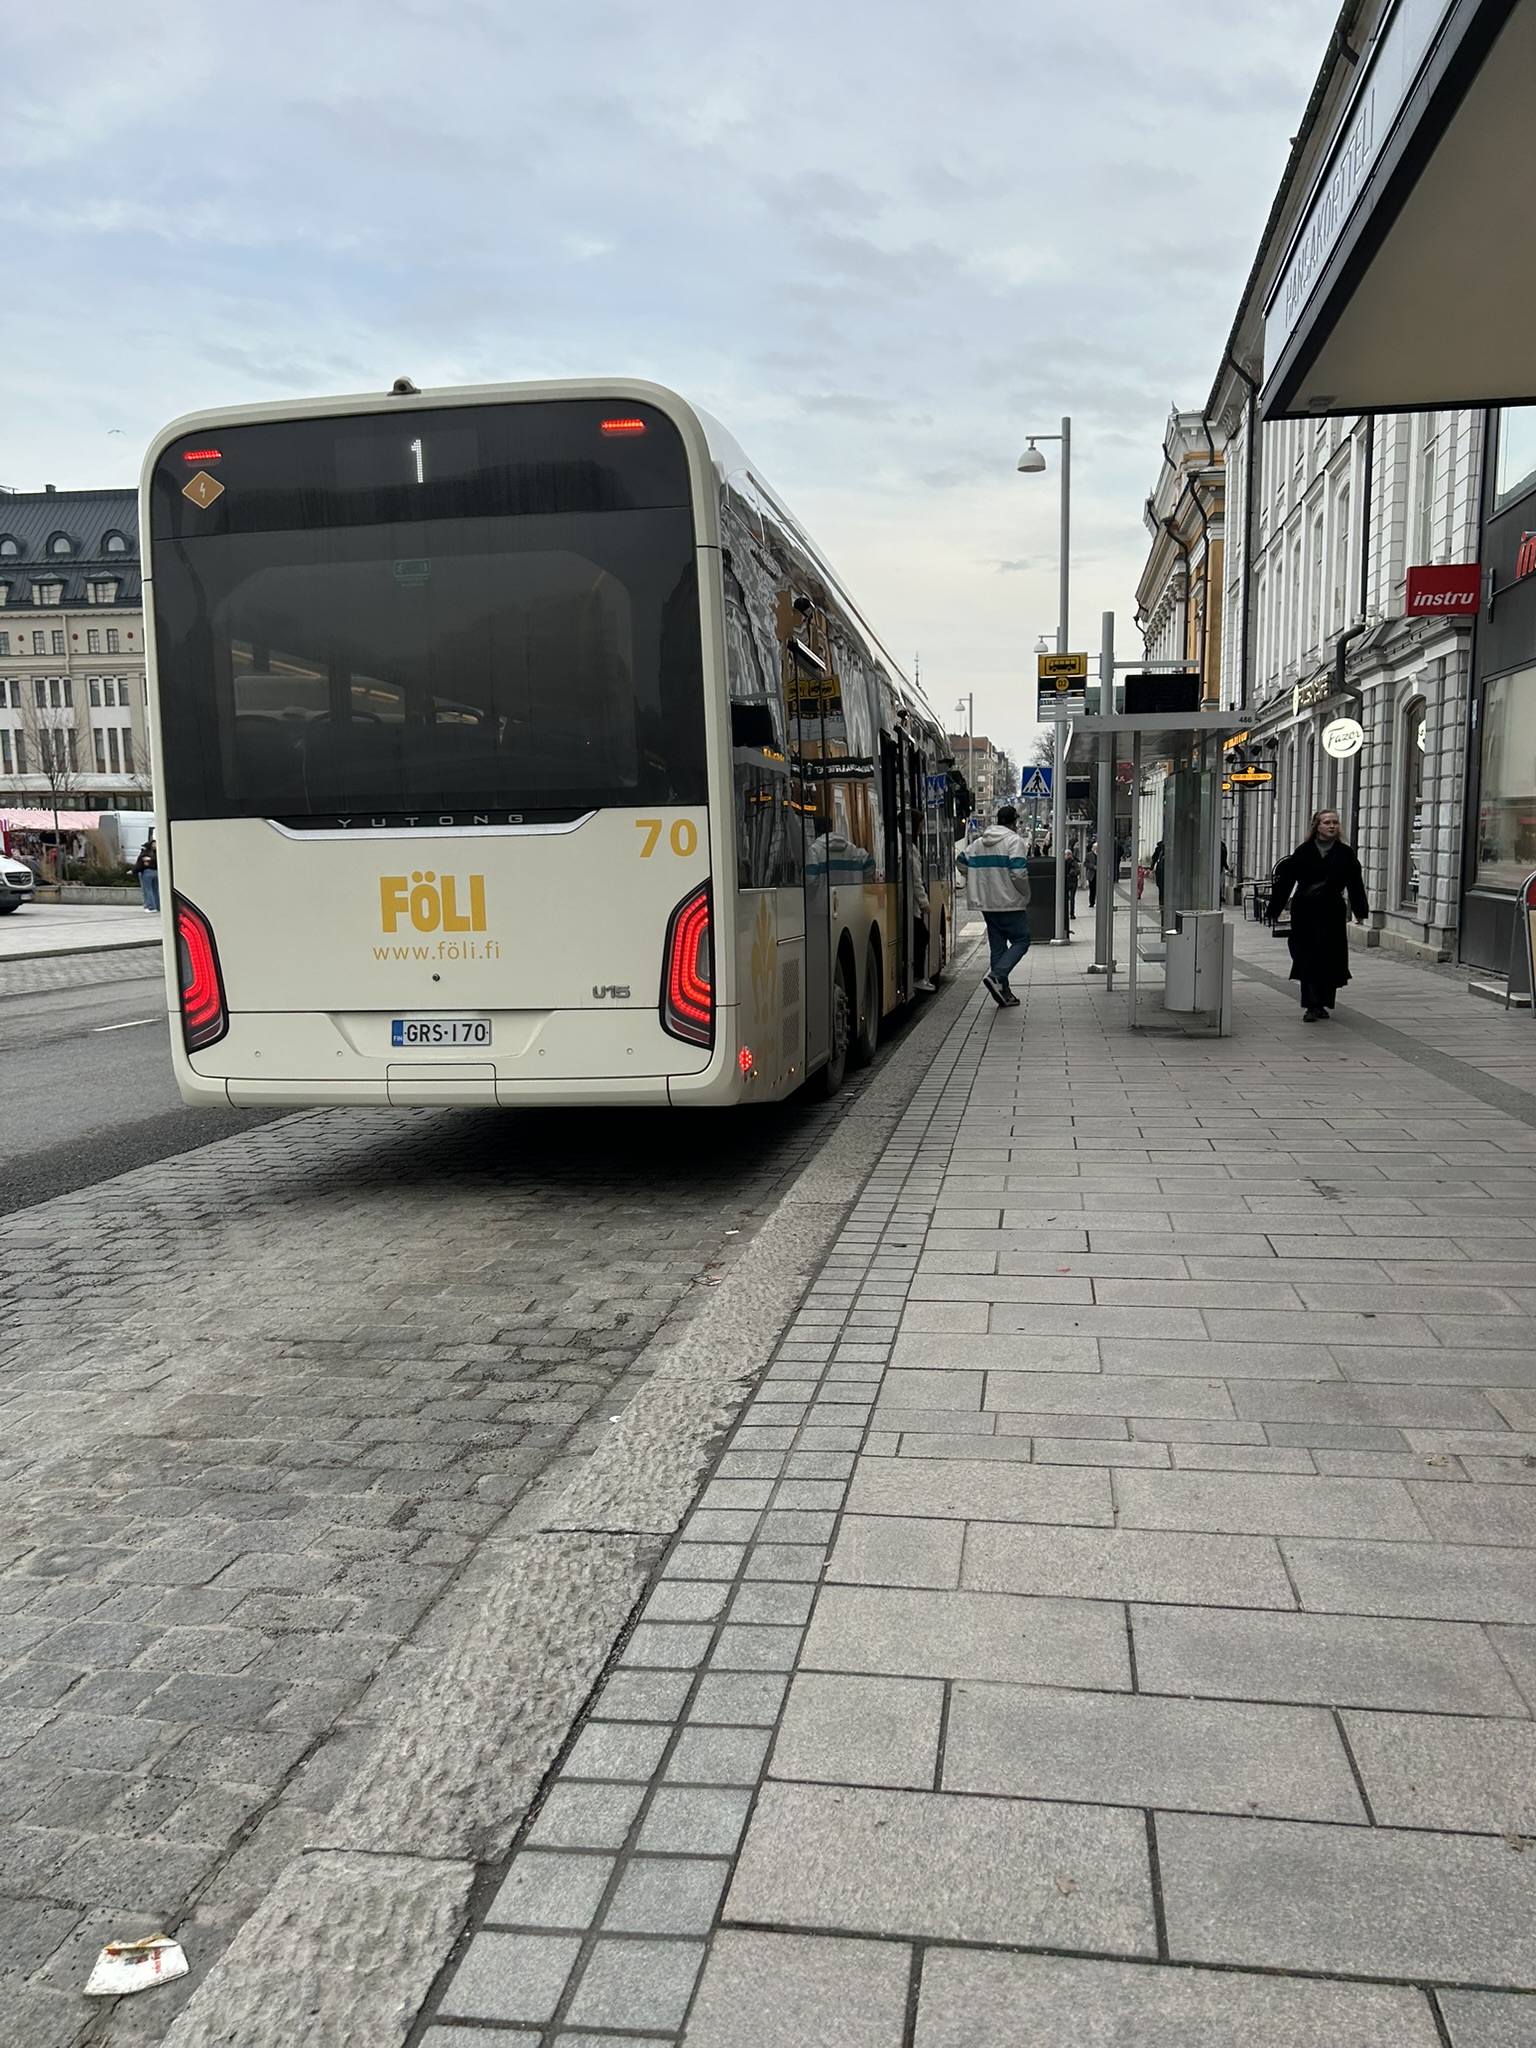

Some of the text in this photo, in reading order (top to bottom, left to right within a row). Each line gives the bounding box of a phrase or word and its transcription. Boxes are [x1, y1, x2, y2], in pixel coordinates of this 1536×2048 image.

[1285, 88, 1375, 328] HANSAKORTTELI
[411, 439, 423, 483] 1
[1413, 591, 1474, 606] instru
[1328, 725, 1362, 749] Fazer
[338, 814, 523, 828] YUTONG
[635, 818, 698, 858] 70
[380, 870, 487, 933] FÖLI
[373, 941, 500, 960] www.föli.fi
[592, 985, 631, 999] U15
[407, 1023, 486, 1042] GRS-170
